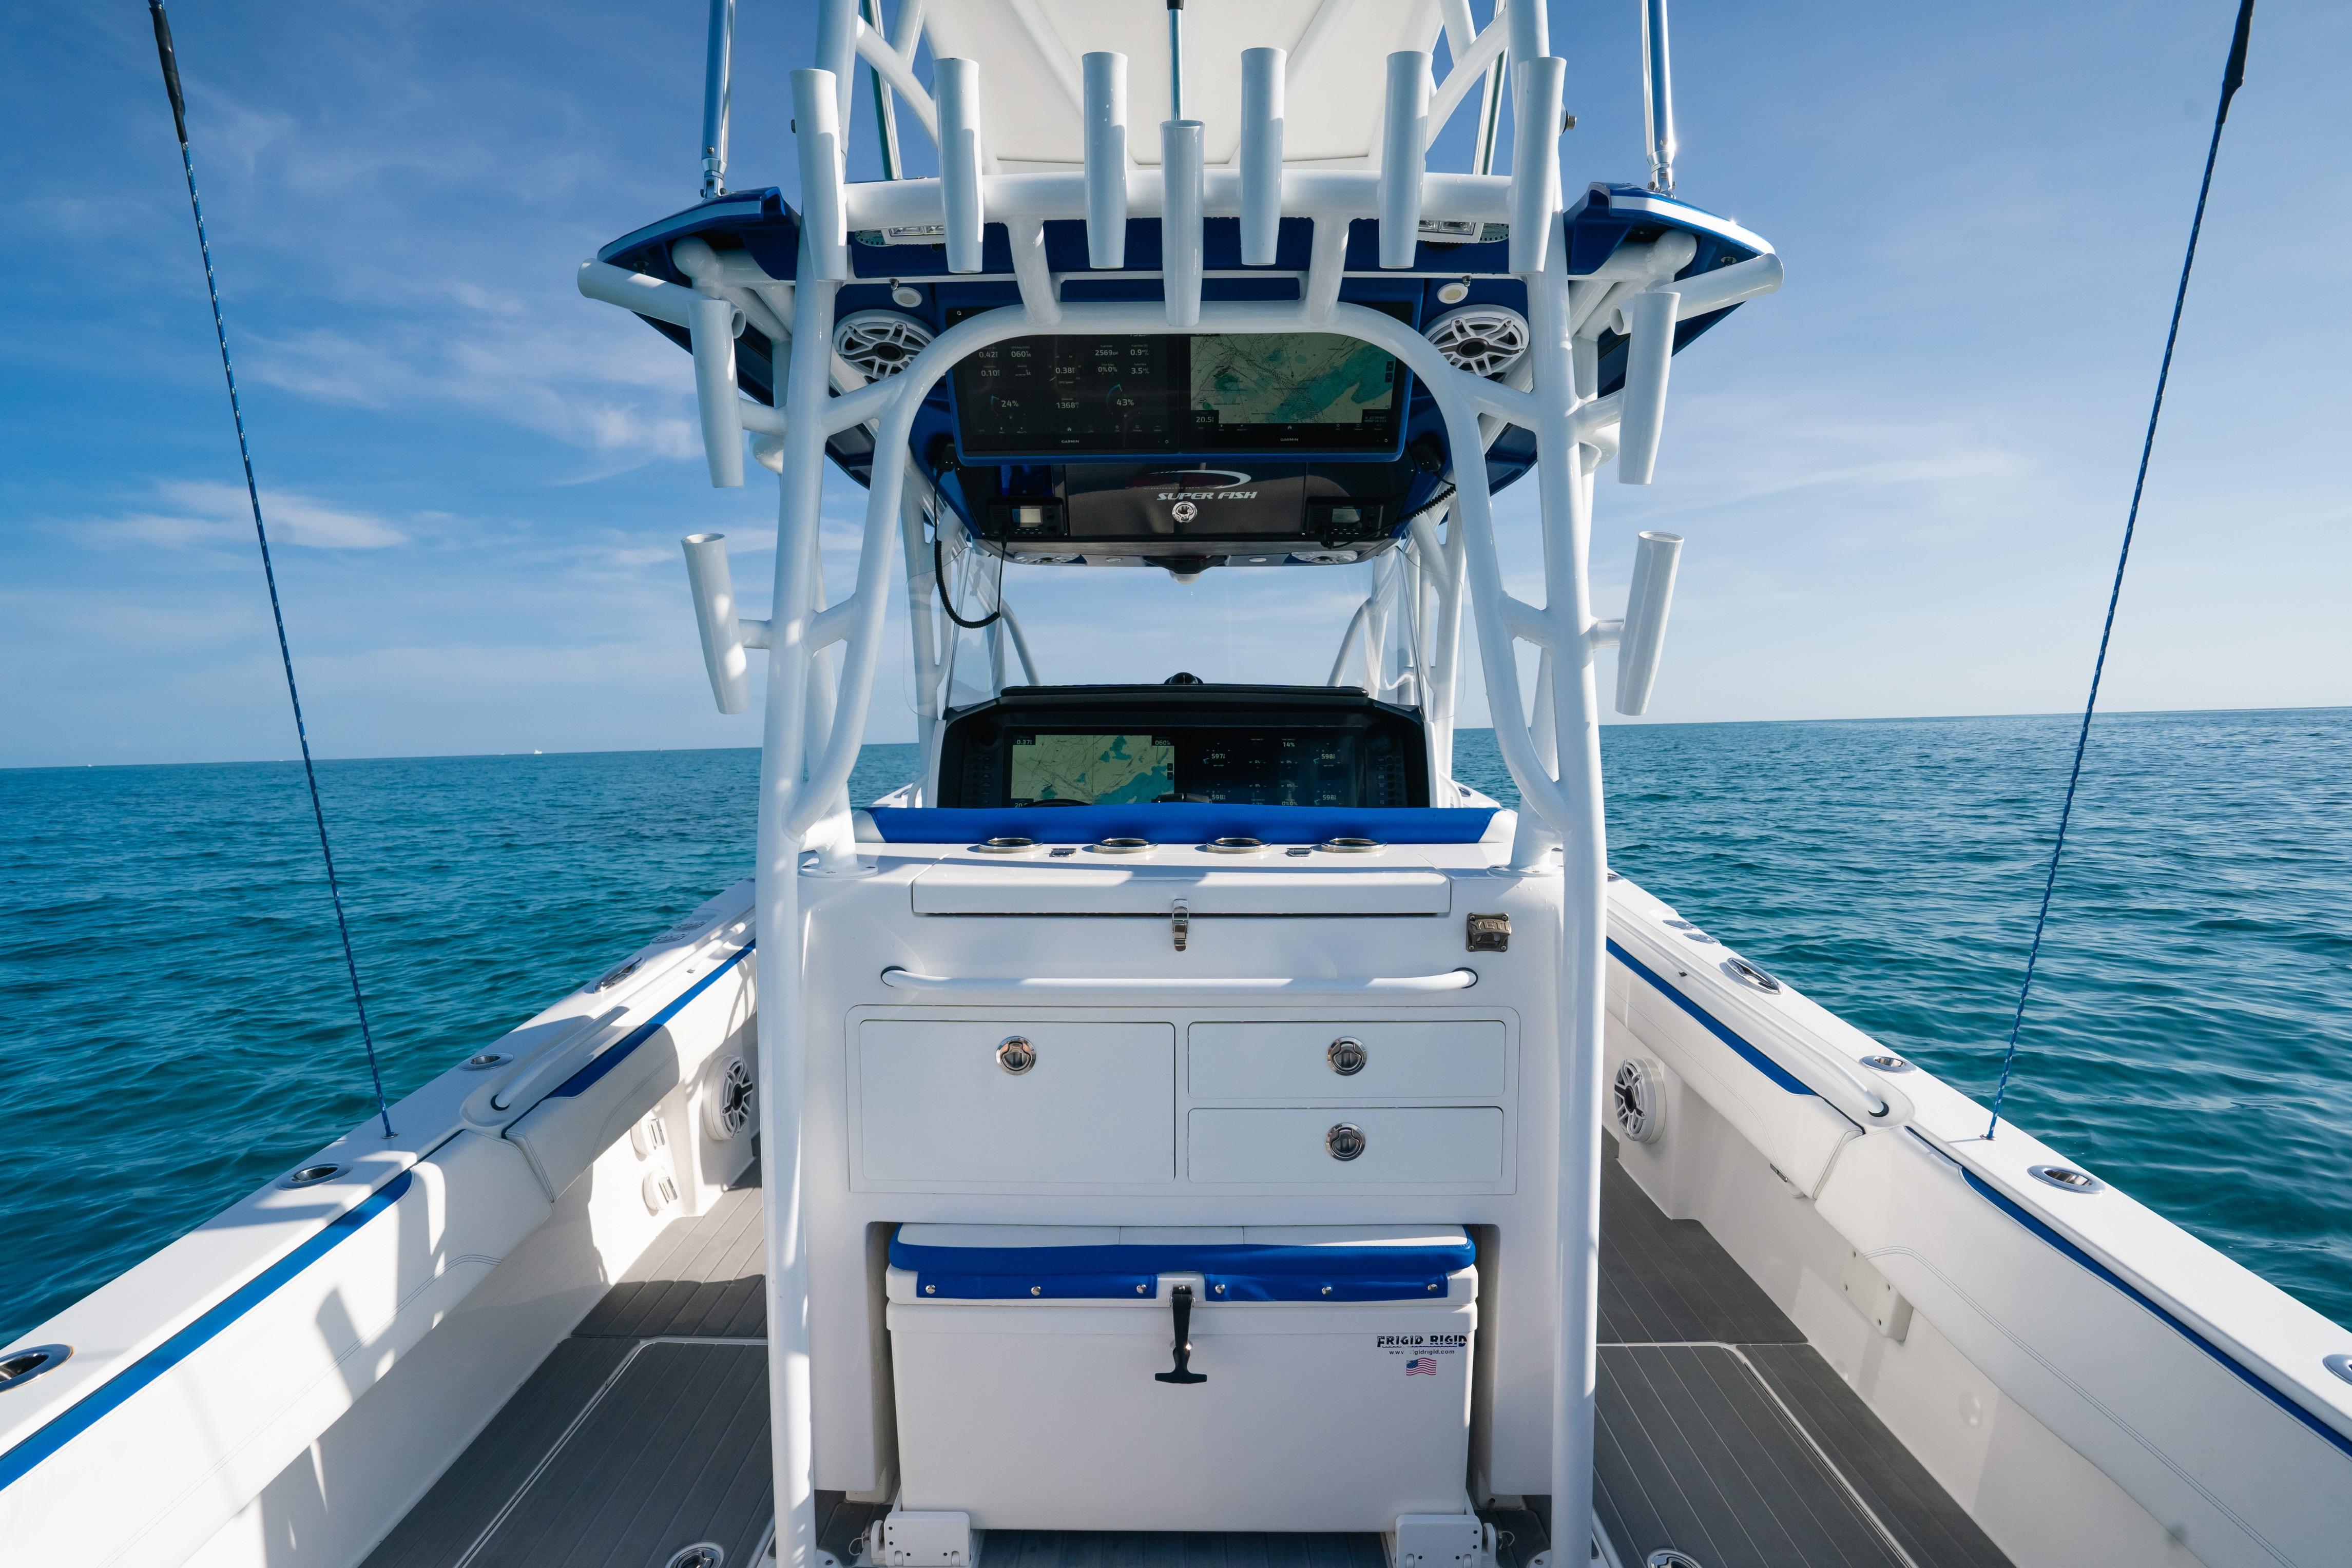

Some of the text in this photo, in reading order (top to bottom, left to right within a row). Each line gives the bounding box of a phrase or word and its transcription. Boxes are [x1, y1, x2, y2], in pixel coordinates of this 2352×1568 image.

[1156, 491, 1258, 500] SUPER FISH
[1471, 920, 1509, 931] YETI
[1377, 1335, 1467, 1347] FRIGID RIGID
